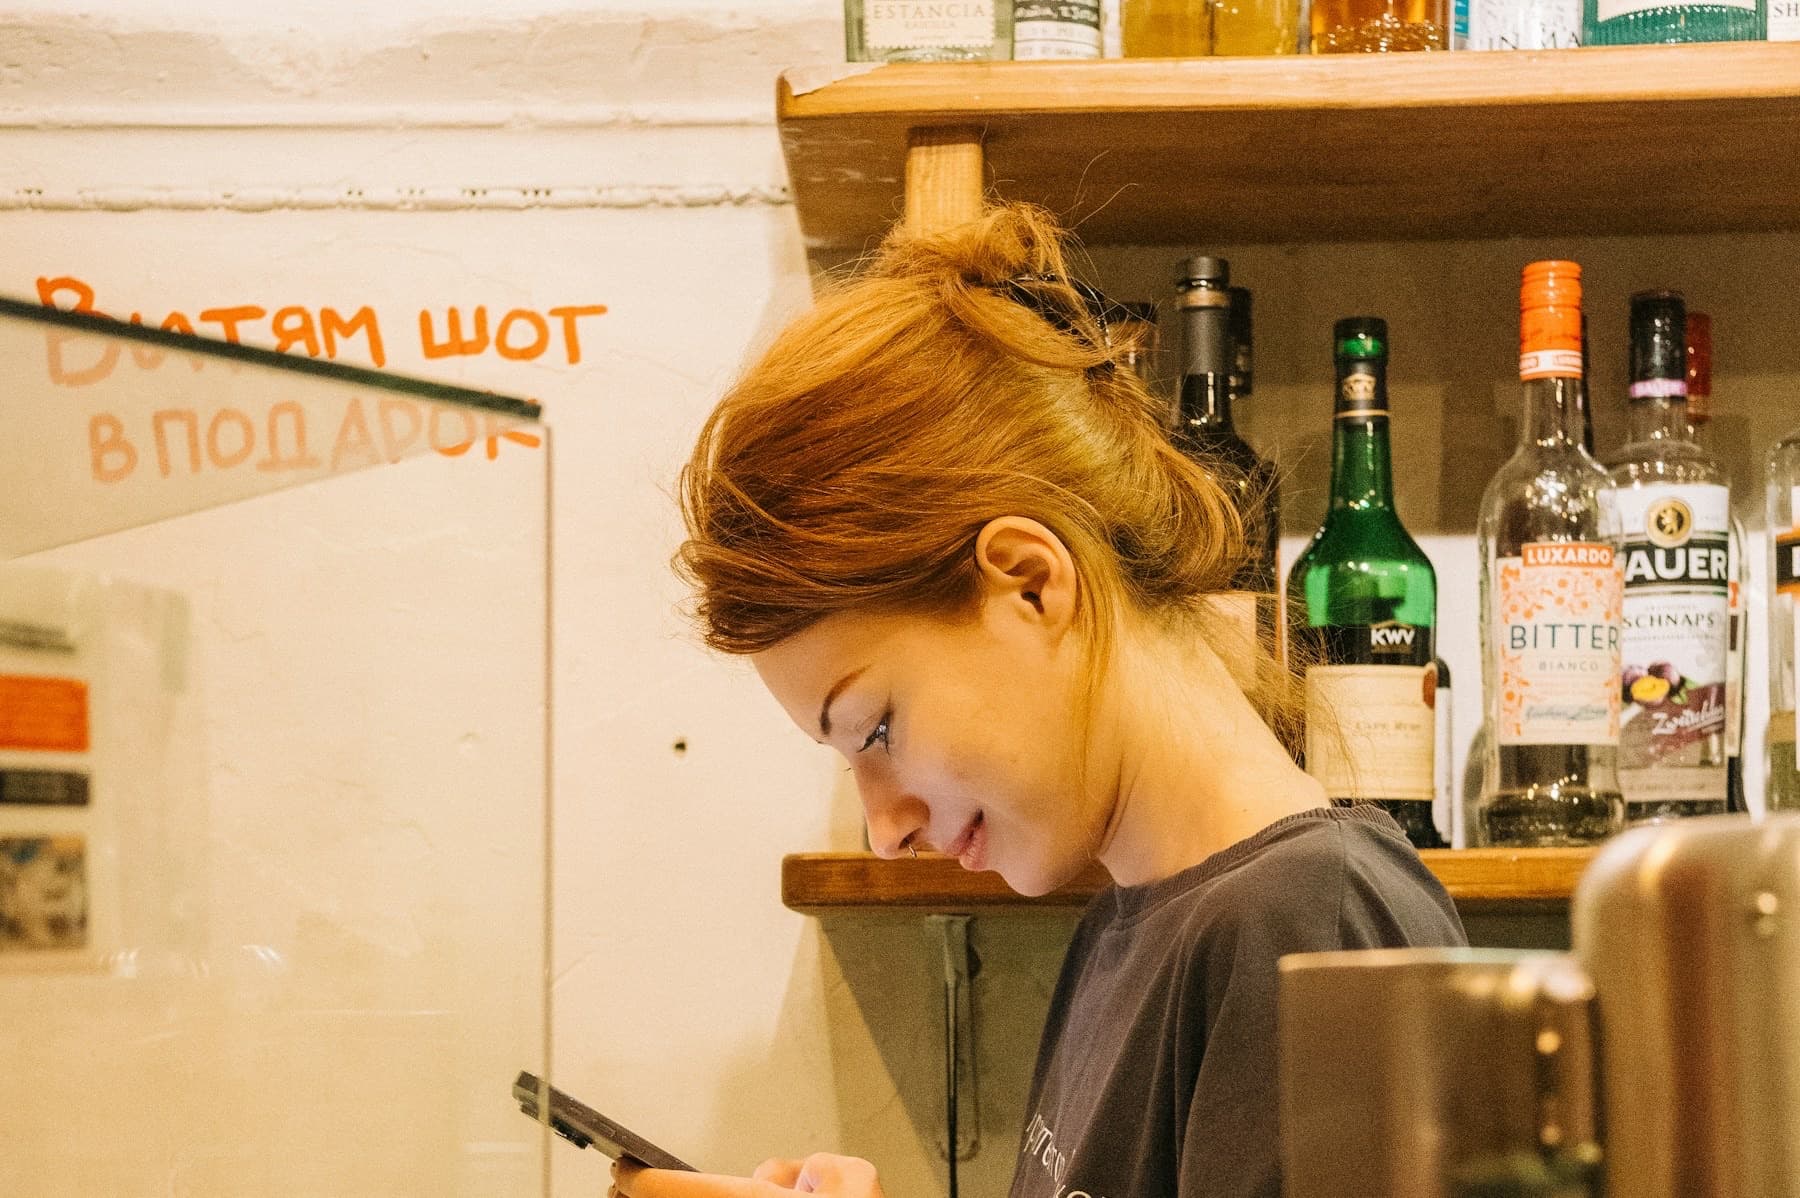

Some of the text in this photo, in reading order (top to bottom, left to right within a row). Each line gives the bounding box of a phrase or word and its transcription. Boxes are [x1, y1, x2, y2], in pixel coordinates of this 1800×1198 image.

[873, 4, 985, 19] ESTANCIA
[419, 304, 608, 365] ШОТ
[1527, 547, 1610, 565] LUXARDO
[1622, 612, 1715, 629] SCHNAPS
[1371, 628, 1415, 646] KWV
[1511, 623, 1619, 650] BITTER
[1539, 661, 1599, 672] BIANCO
